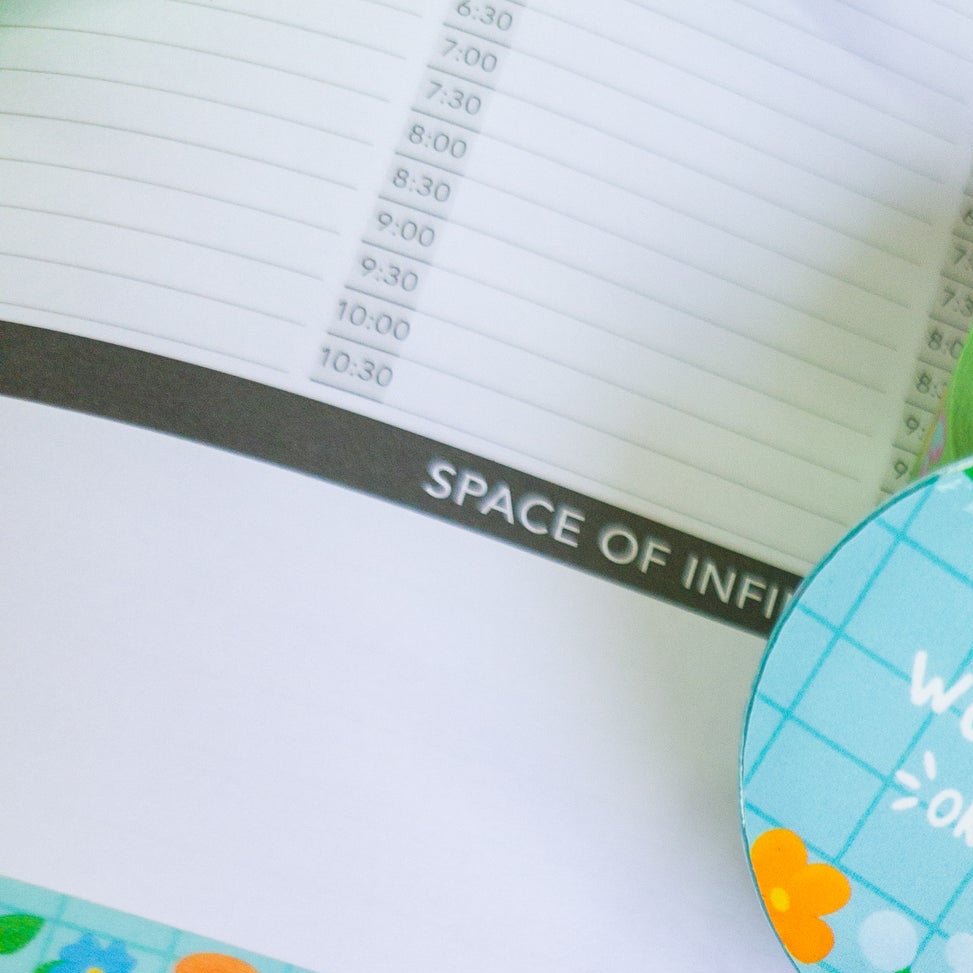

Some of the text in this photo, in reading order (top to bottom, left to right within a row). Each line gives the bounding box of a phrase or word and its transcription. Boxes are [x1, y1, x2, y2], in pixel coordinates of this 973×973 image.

[456, 0, 513, 31] 6:30
[443, 37, 498, 73] 7:00
[425, 80, 482, 116] 7:30
[408, 123, 468, 159] 8:00
[392, 167, 452, 203] 8:30
[376, 211, 436, 248] 9:00
[360, 256, 419, 292] 9:30
[337, 300, 411, 341] 10:00
[320, 347, 394, 388] 10:30
[423, 461, 794, 621] SPACE OF INFI
